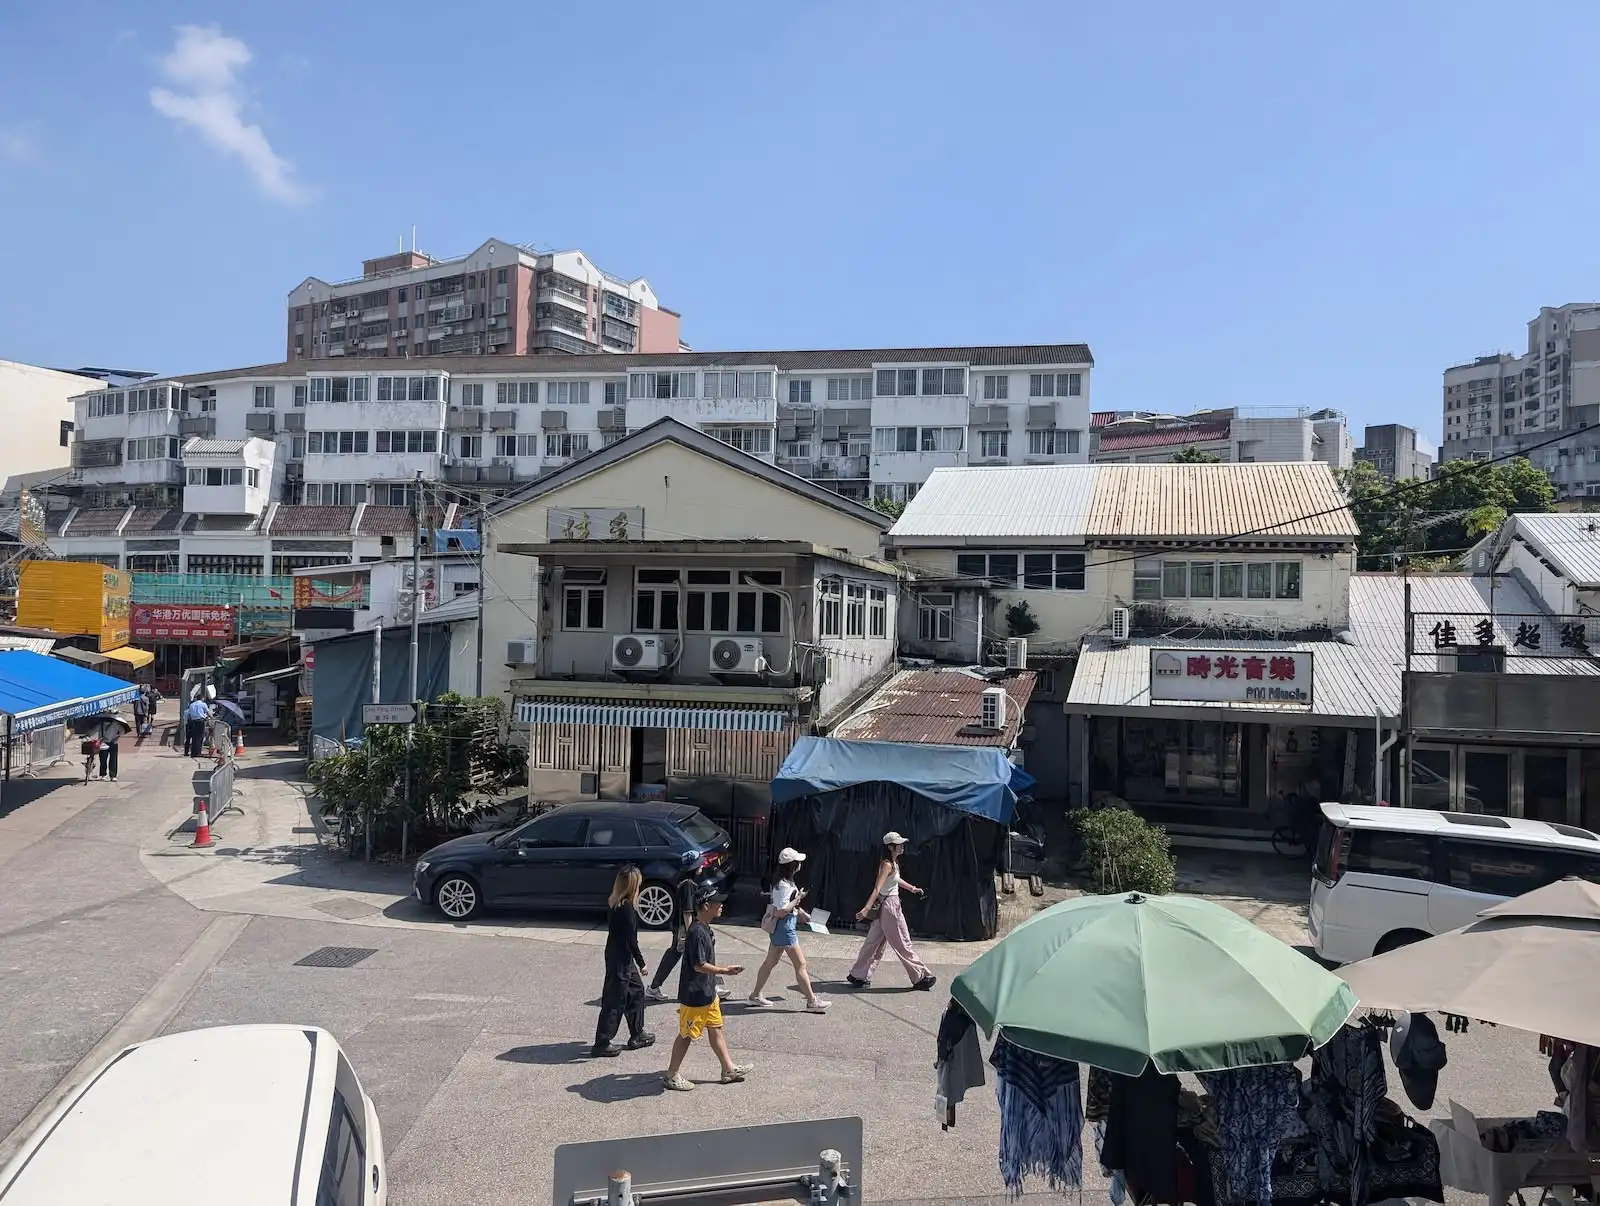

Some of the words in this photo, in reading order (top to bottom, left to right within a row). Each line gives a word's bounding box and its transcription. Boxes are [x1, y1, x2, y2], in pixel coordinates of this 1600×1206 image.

[1186, 655, 1296, 681] 時光音樂
[1268, 687, 1308, 701] Music
